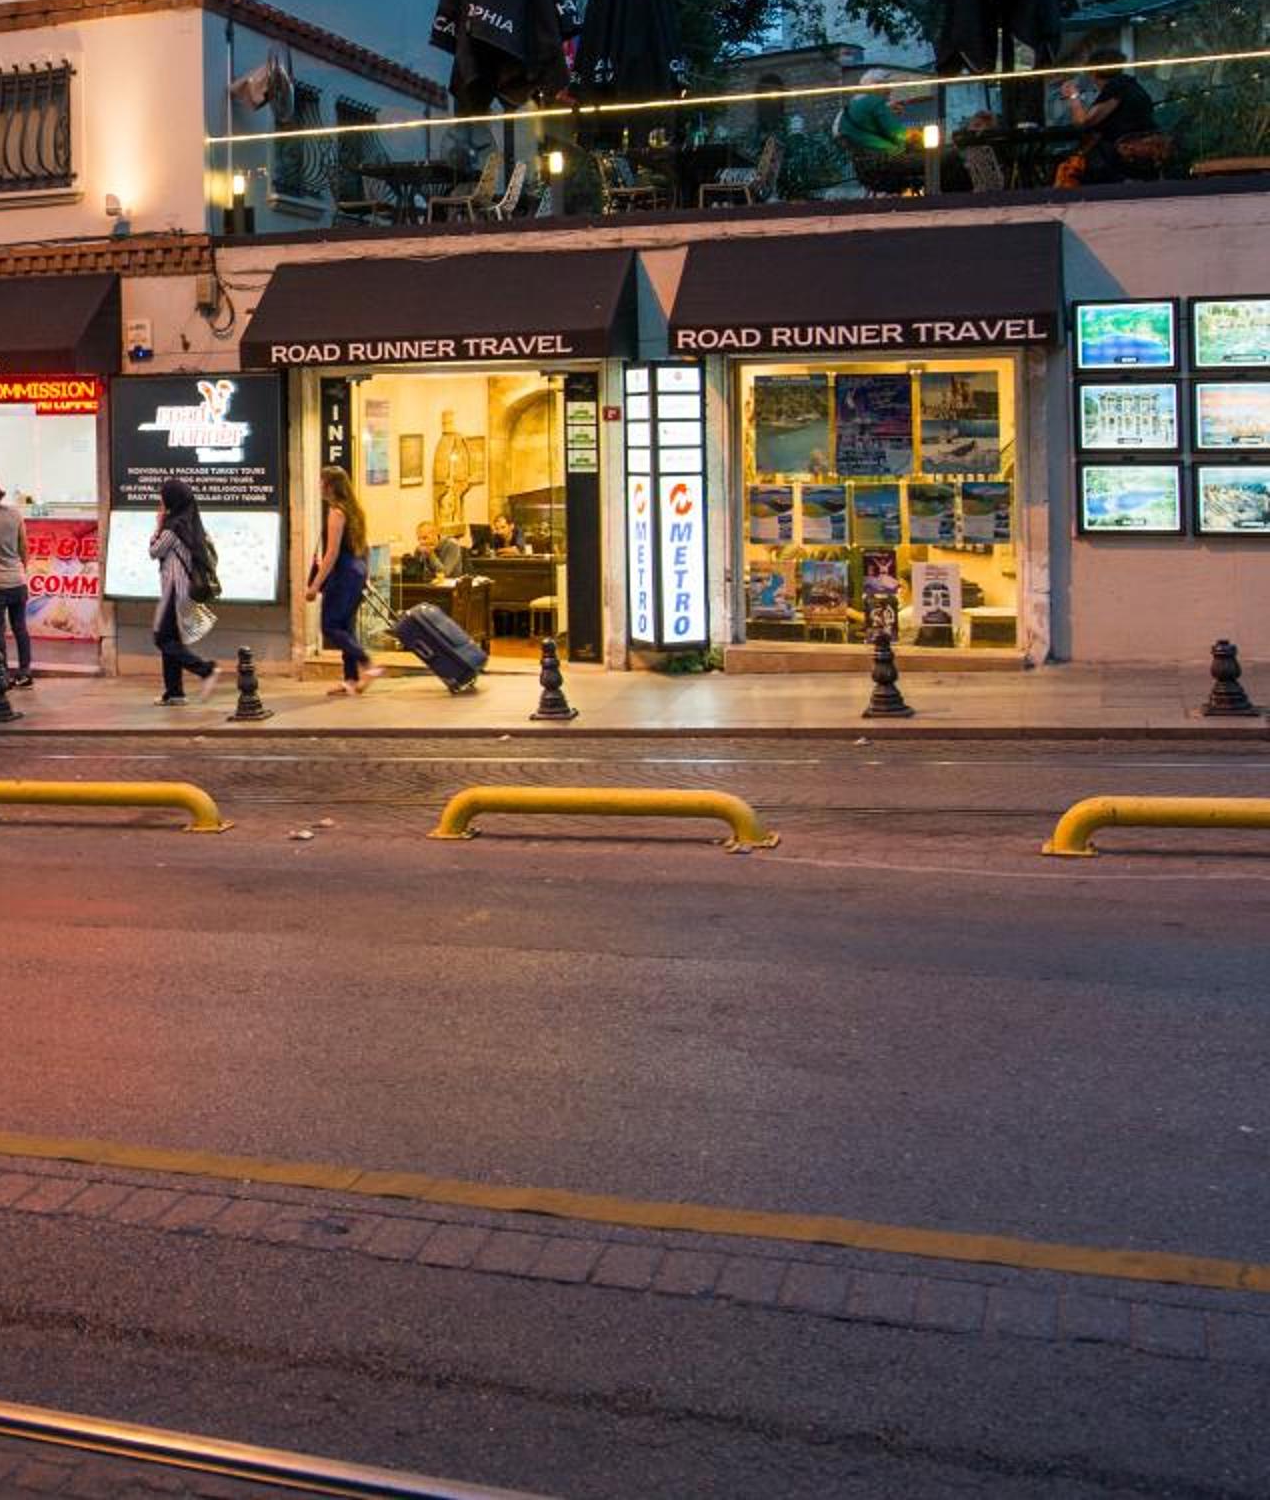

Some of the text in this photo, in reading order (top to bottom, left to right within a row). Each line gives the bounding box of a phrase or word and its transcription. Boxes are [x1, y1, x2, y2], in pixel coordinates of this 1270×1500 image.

[271, 335, 573, 363] ROAD RUNNER TRAVEL
[677, 319, 1048, 349] ROAD RUNNER TRAVEL
[634, 520, 648, 634] METRO
[669, 520, 693, 636] METRO
